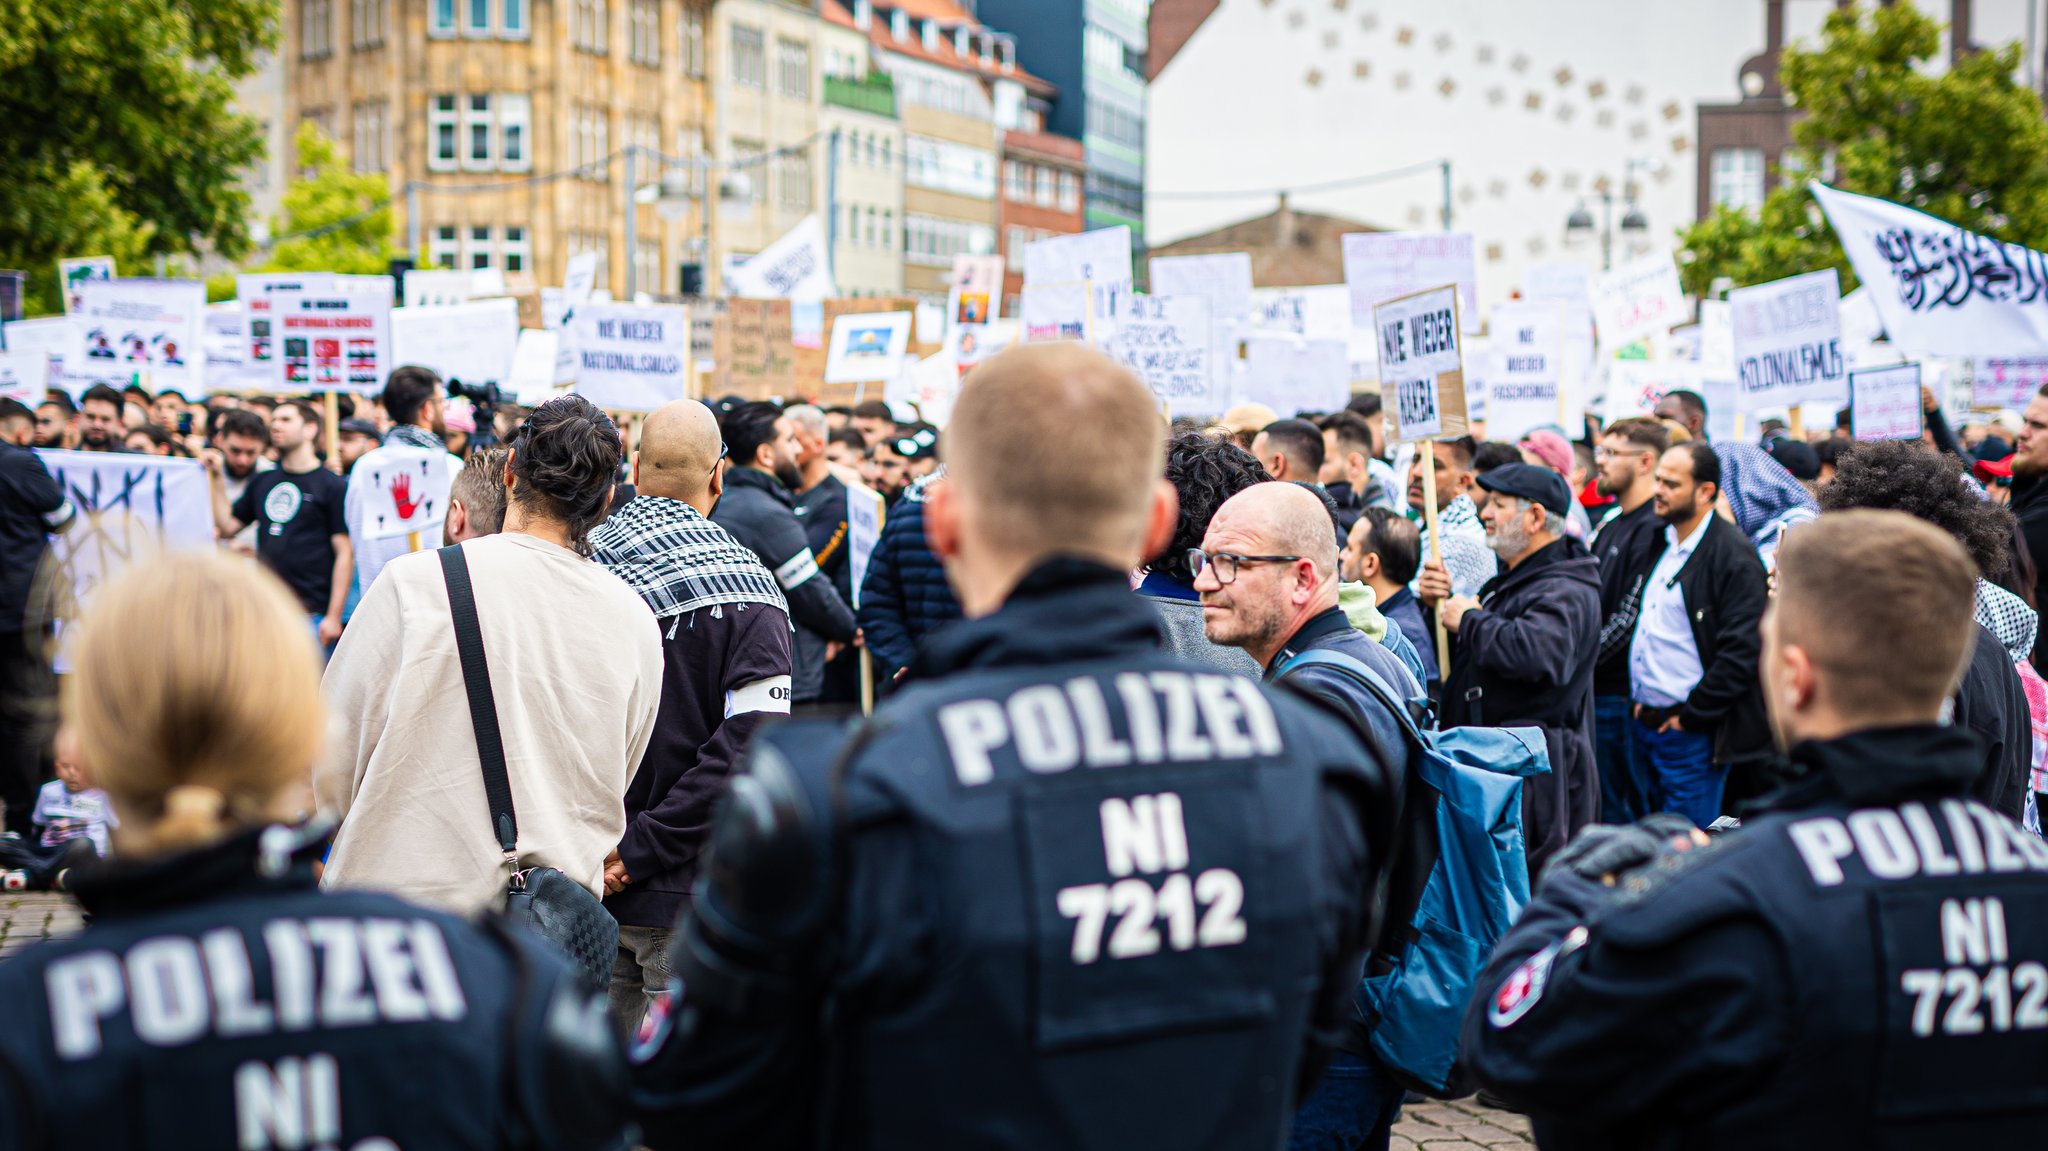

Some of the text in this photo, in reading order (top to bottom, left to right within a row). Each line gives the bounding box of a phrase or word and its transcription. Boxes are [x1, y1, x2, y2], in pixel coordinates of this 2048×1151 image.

[597, 319, 662, 341] NIE WIEDER
[1383, 308, 1454, 365] NIE WIEDER
[1507, 355, 1545, 373] WIEDER
[1518, 327, 1534, 343] NIE
[1399, 378, 1435, 427] NAKBA
[1493, 382, 1557, 401] FASCHISMUS
[938, 671, 1283, 788] POLIZEI
[1100, 791, 1190, 878] NI
[1056, 867, 1248, 965] 7212
[1940, 896, 2009, 965] NI
[45, 916, 468, 1061] POLIZEI
[1900, 961, 2048, 1038] 7212
[234, 1052, 342, 1151] NI
